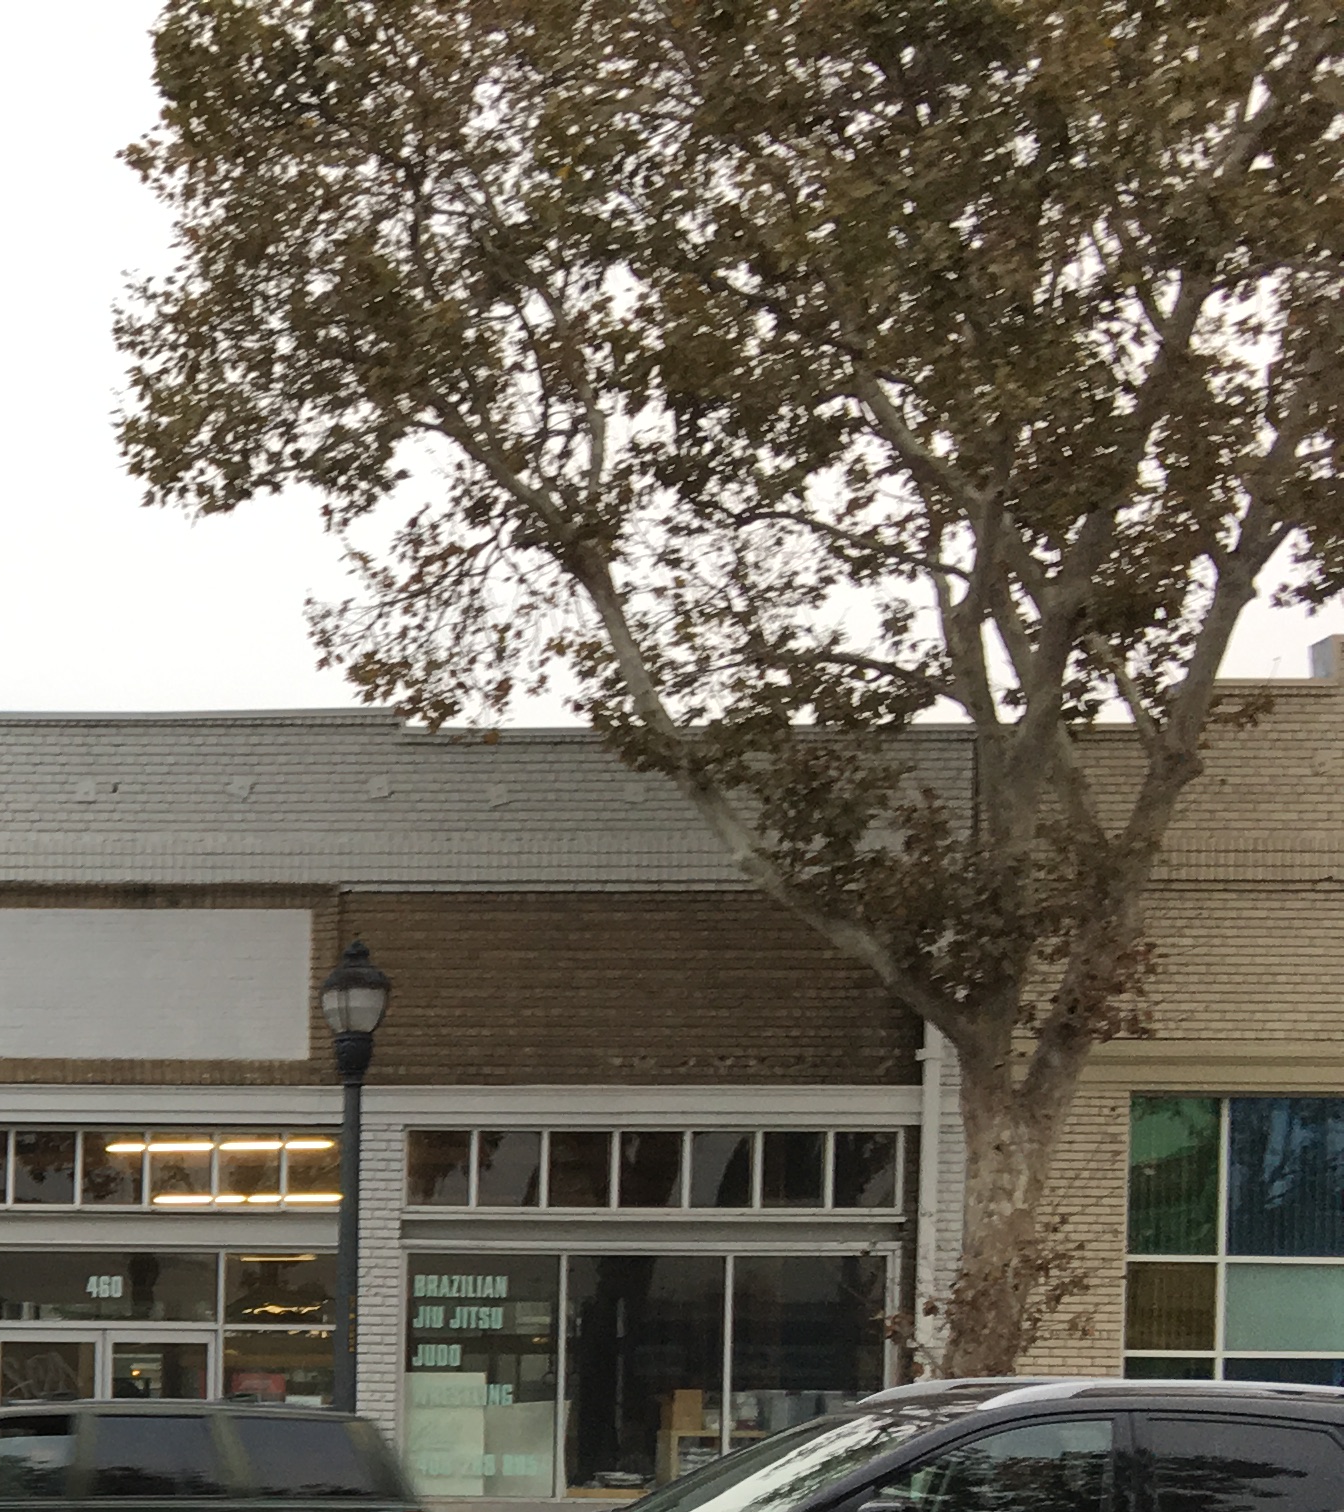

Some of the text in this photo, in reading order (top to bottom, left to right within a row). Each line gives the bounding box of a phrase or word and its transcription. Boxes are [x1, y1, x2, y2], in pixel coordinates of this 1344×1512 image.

[85, 1275, 124, 1299] 460
[413, 1274, 509, 1298] BRAZILIAN
[412, 1305, 504, 1329] JIU JITSU
[412, 1343, 462, 1367] JUDO
